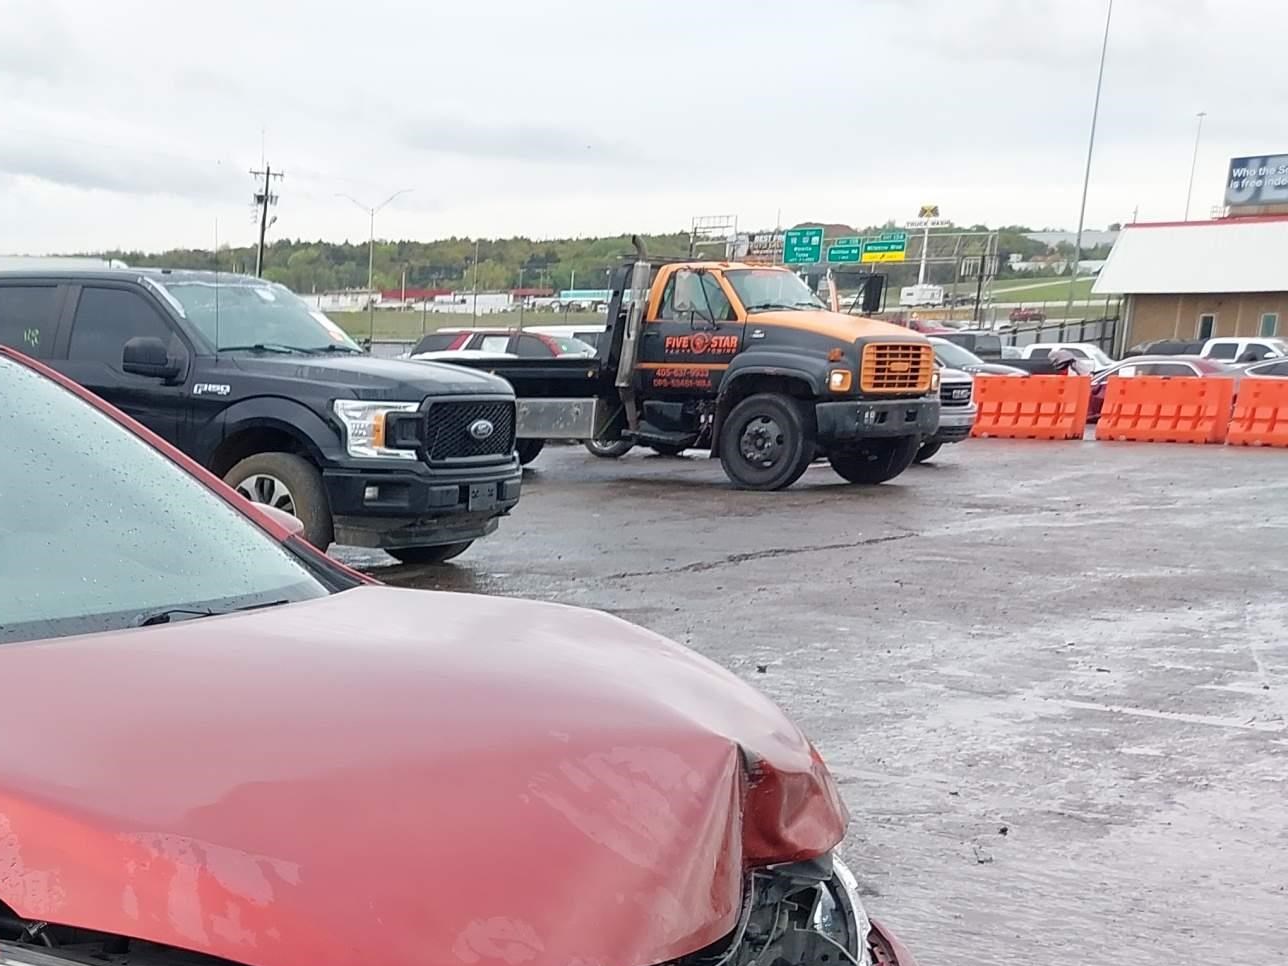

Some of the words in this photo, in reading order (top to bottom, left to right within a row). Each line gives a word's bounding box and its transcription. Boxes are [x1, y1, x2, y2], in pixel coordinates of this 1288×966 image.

[1232, 168, 1256, 177] Who
[1258, 166, 1275, 176] the
[1240, 178, 1263, 188] free
[665, 335, 689, 349] FIVE
[710, 335, 739, 349] STAR
